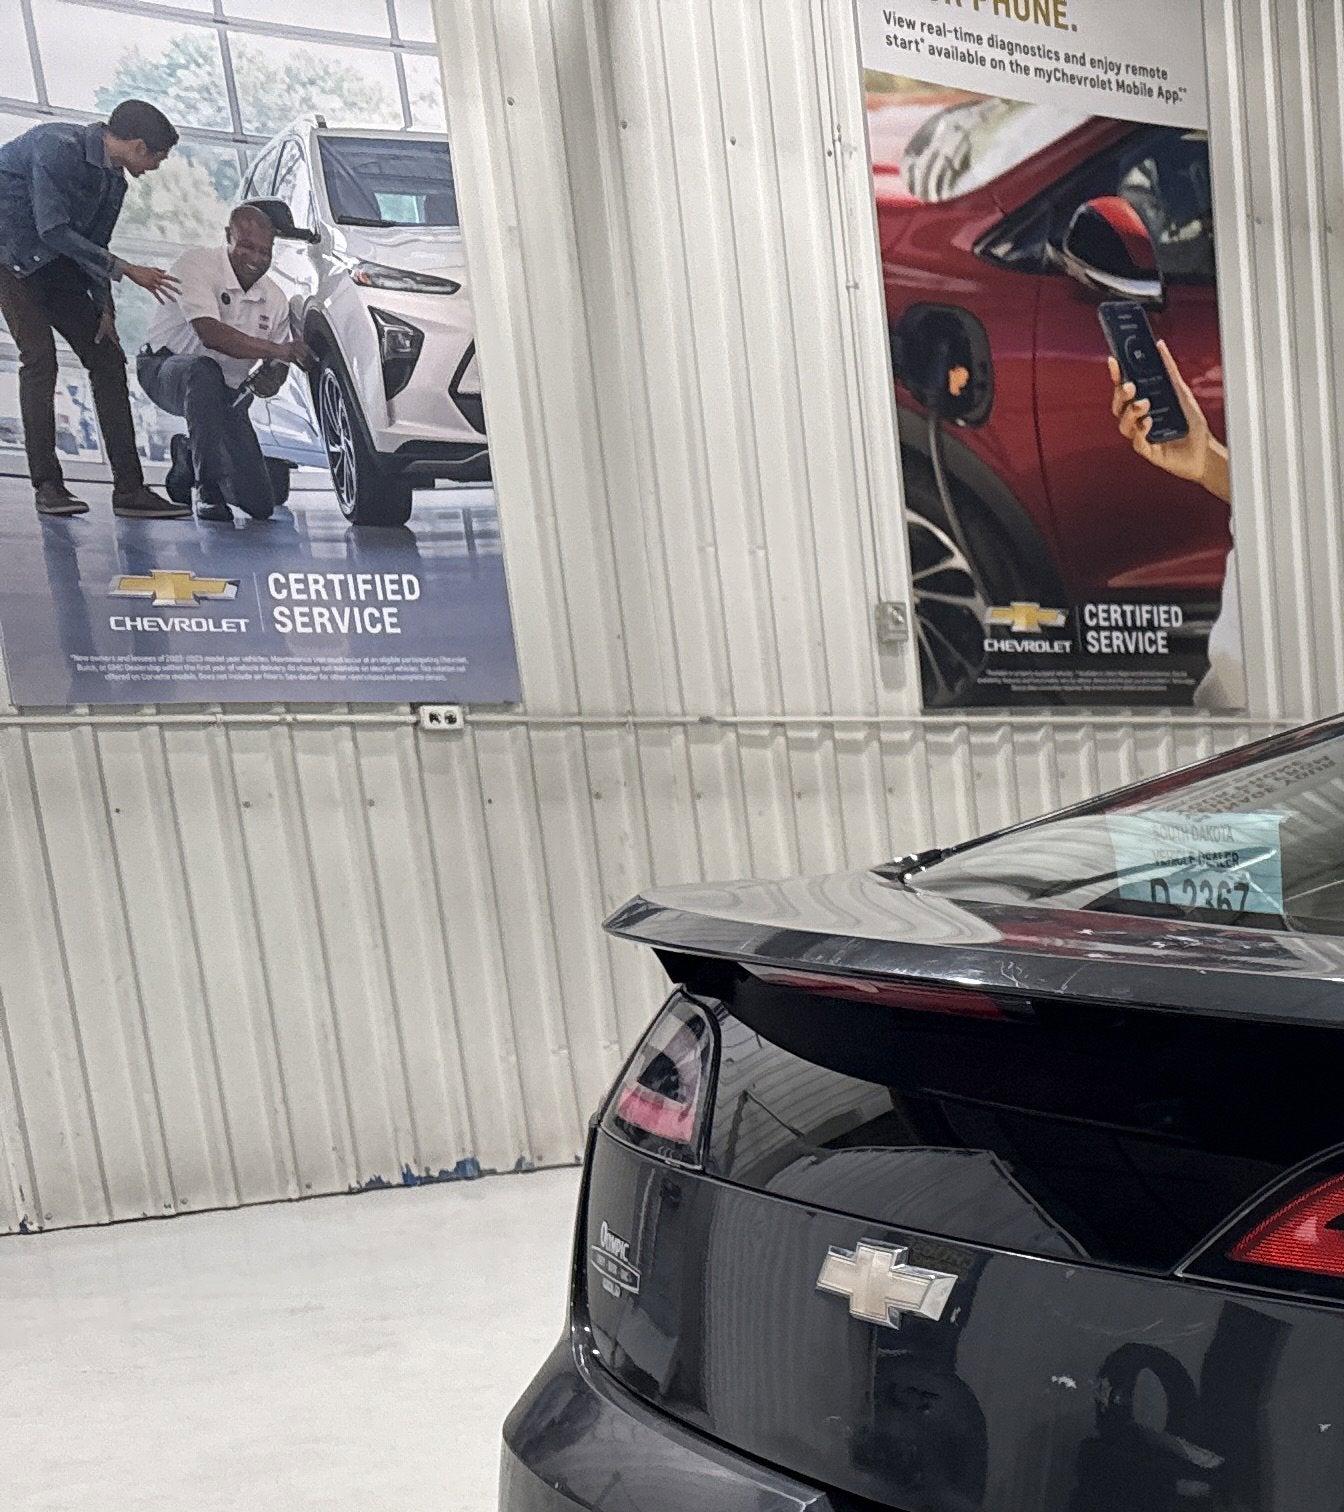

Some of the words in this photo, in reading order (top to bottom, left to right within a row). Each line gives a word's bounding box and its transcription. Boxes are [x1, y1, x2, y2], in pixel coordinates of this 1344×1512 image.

[883, 9, 916, 31] View
[920, 20, 984, 46] real-time
[987, 33, 1060, 62] diagnostics
[1064, 52, 1087, 67] and
[1089, 56, 1122, 76] enjoy
[1125, 63, 1168, 81] remote
[928, 44, 987, 67] available
[990, 57, 1006, 71] on
[1009, 59, 1031, 76] the
[1034, 65, 1113, 92] myChevrolet
[1115, 78, 1154, 98] Mobile
[267, 572, 421, 601] CERTIFIED
[109, 616, 250, 633] CHEVROLET
[272, 606, 402, 635] SERVICE
[1084, 603, 1183, 628] CERTIFIED
[983, 639, 1073, 654] CHEVROLET
[1086, 630, 1170, 655] SERVICE
[1192, 824, 1235, 843] DAKOTA
[1182, 878, 1250, 911] 2367
